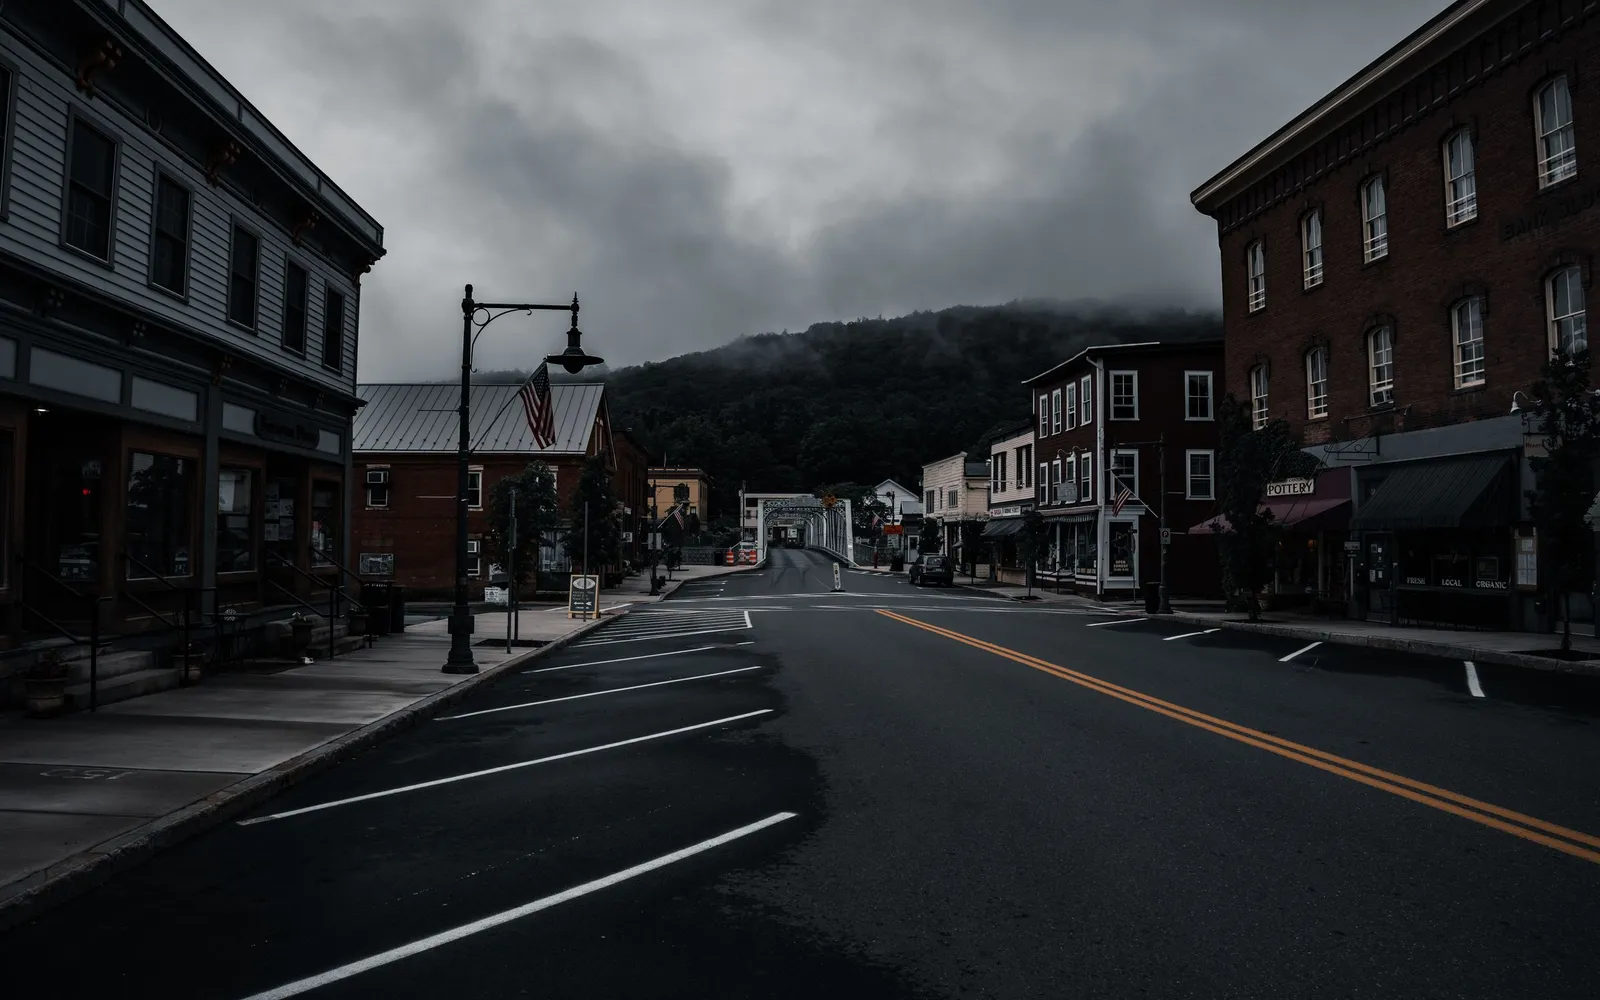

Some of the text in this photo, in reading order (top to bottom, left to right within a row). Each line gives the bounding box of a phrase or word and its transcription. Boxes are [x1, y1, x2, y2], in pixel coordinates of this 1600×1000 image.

[1501, 204, 1551, 241] BANK
[1268, 481, 1313, 495] POTTERY
[1406, 577, 1426, 585] FRESH
[1441, 578, 1463, 587] LOCAL
[1475, 580, 1507, 589] ORGANIC
